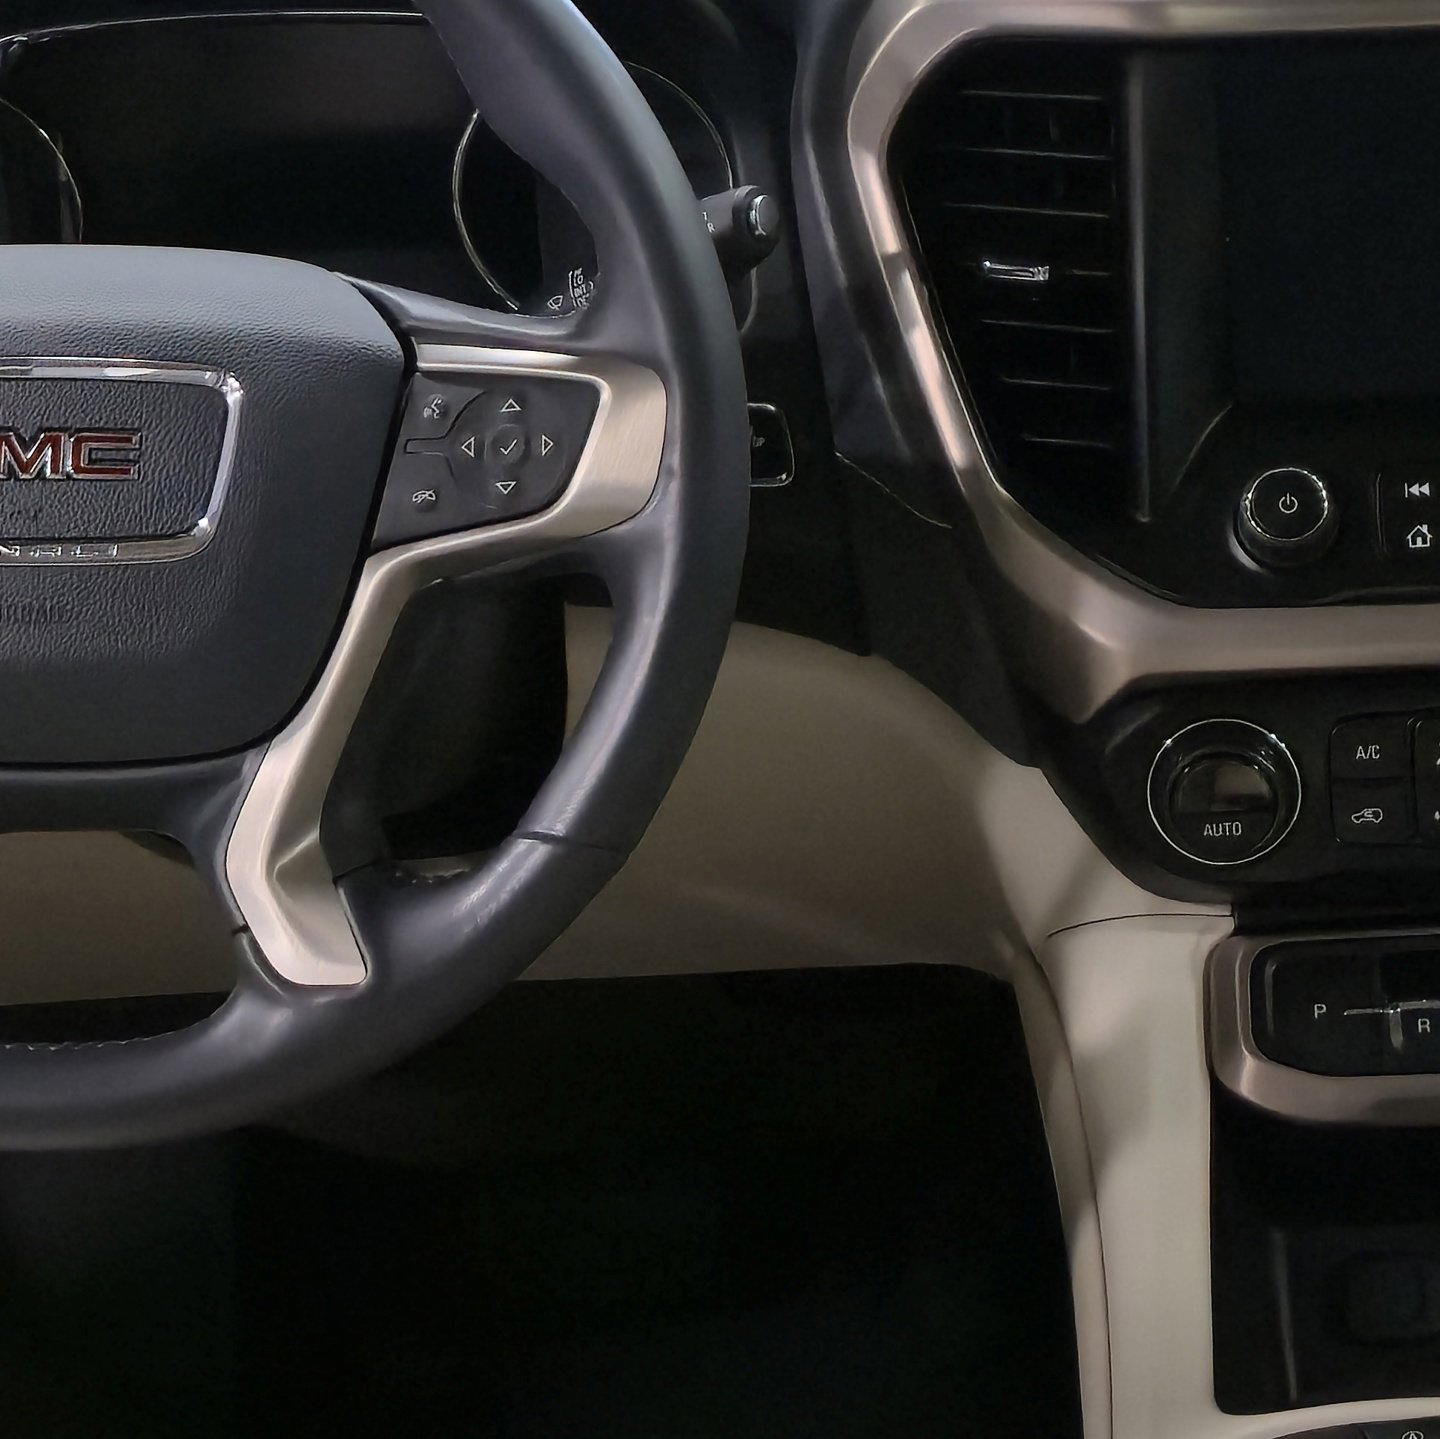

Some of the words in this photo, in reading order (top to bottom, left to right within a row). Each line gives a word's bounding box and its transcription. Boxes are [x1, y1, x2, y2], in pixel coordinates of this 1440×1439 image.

[1355, 744, 1381, 760] A/C
[1203, 821, 1242, 837] AUTO
[1313, 1003, 1327, 1019] P
[1417, 1017, 1431, 1033] R
